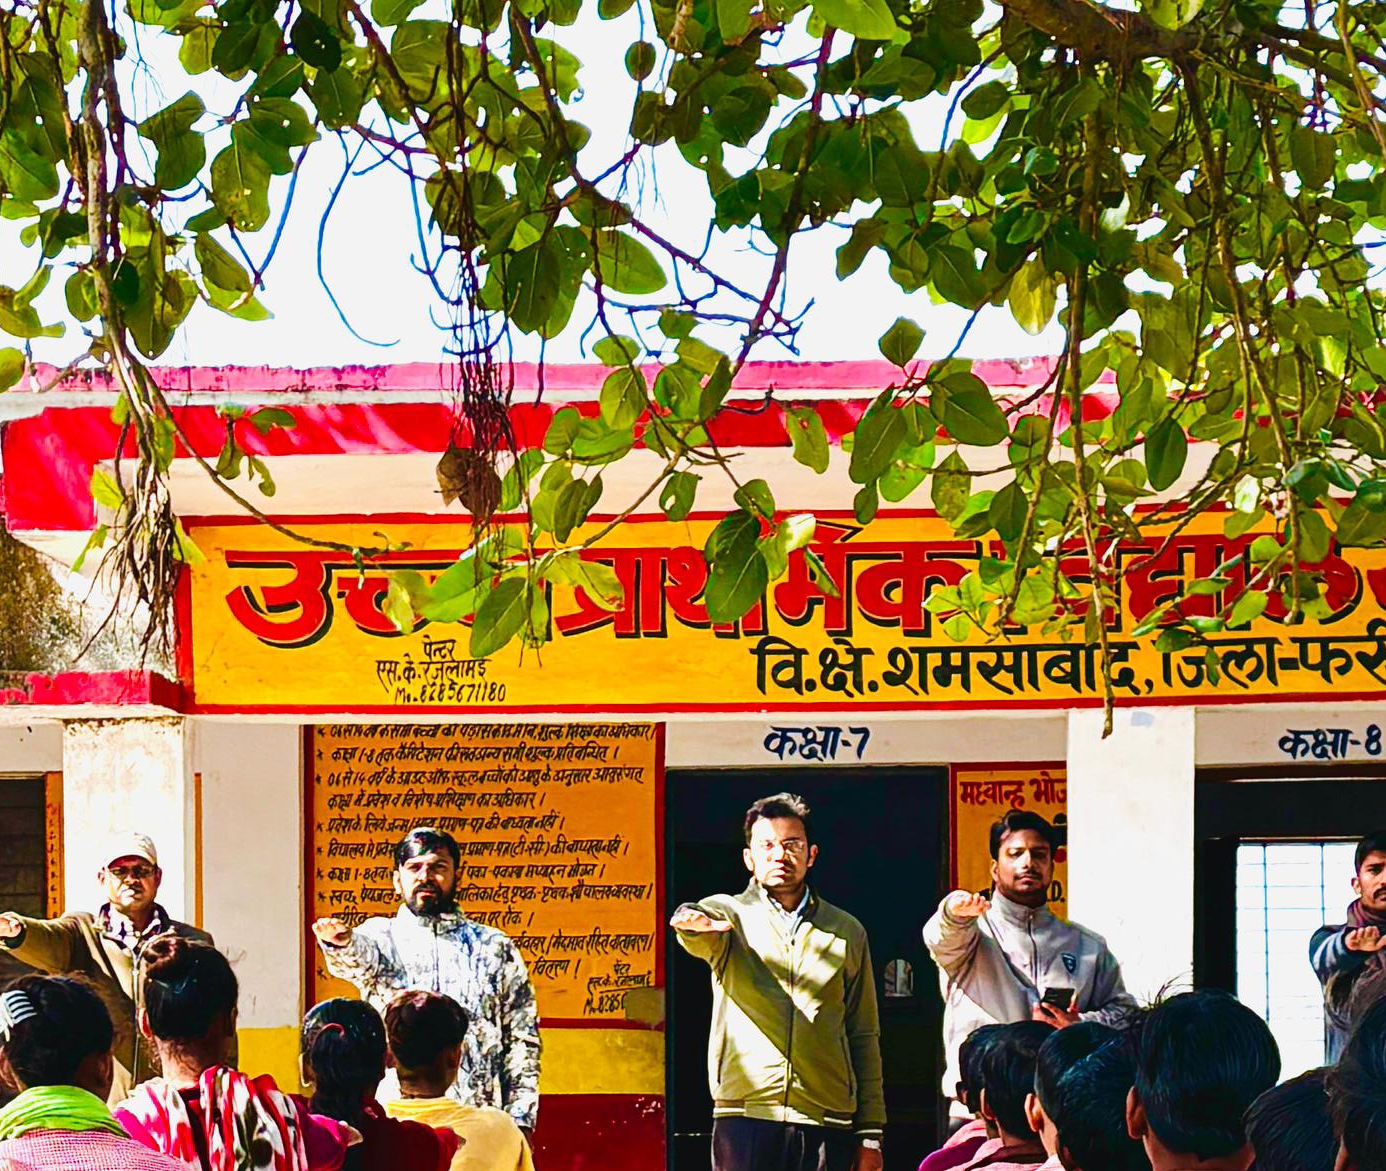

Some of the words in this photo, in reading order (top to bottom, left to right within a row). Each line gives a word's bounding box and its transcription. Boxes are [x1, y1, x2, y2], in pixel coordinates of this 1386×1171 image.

[225, 550, 551, 650] उच्
[763, 725, 871, 762] कक्षा-7
[1278, 723, 1382, 760] कक्षा-8
